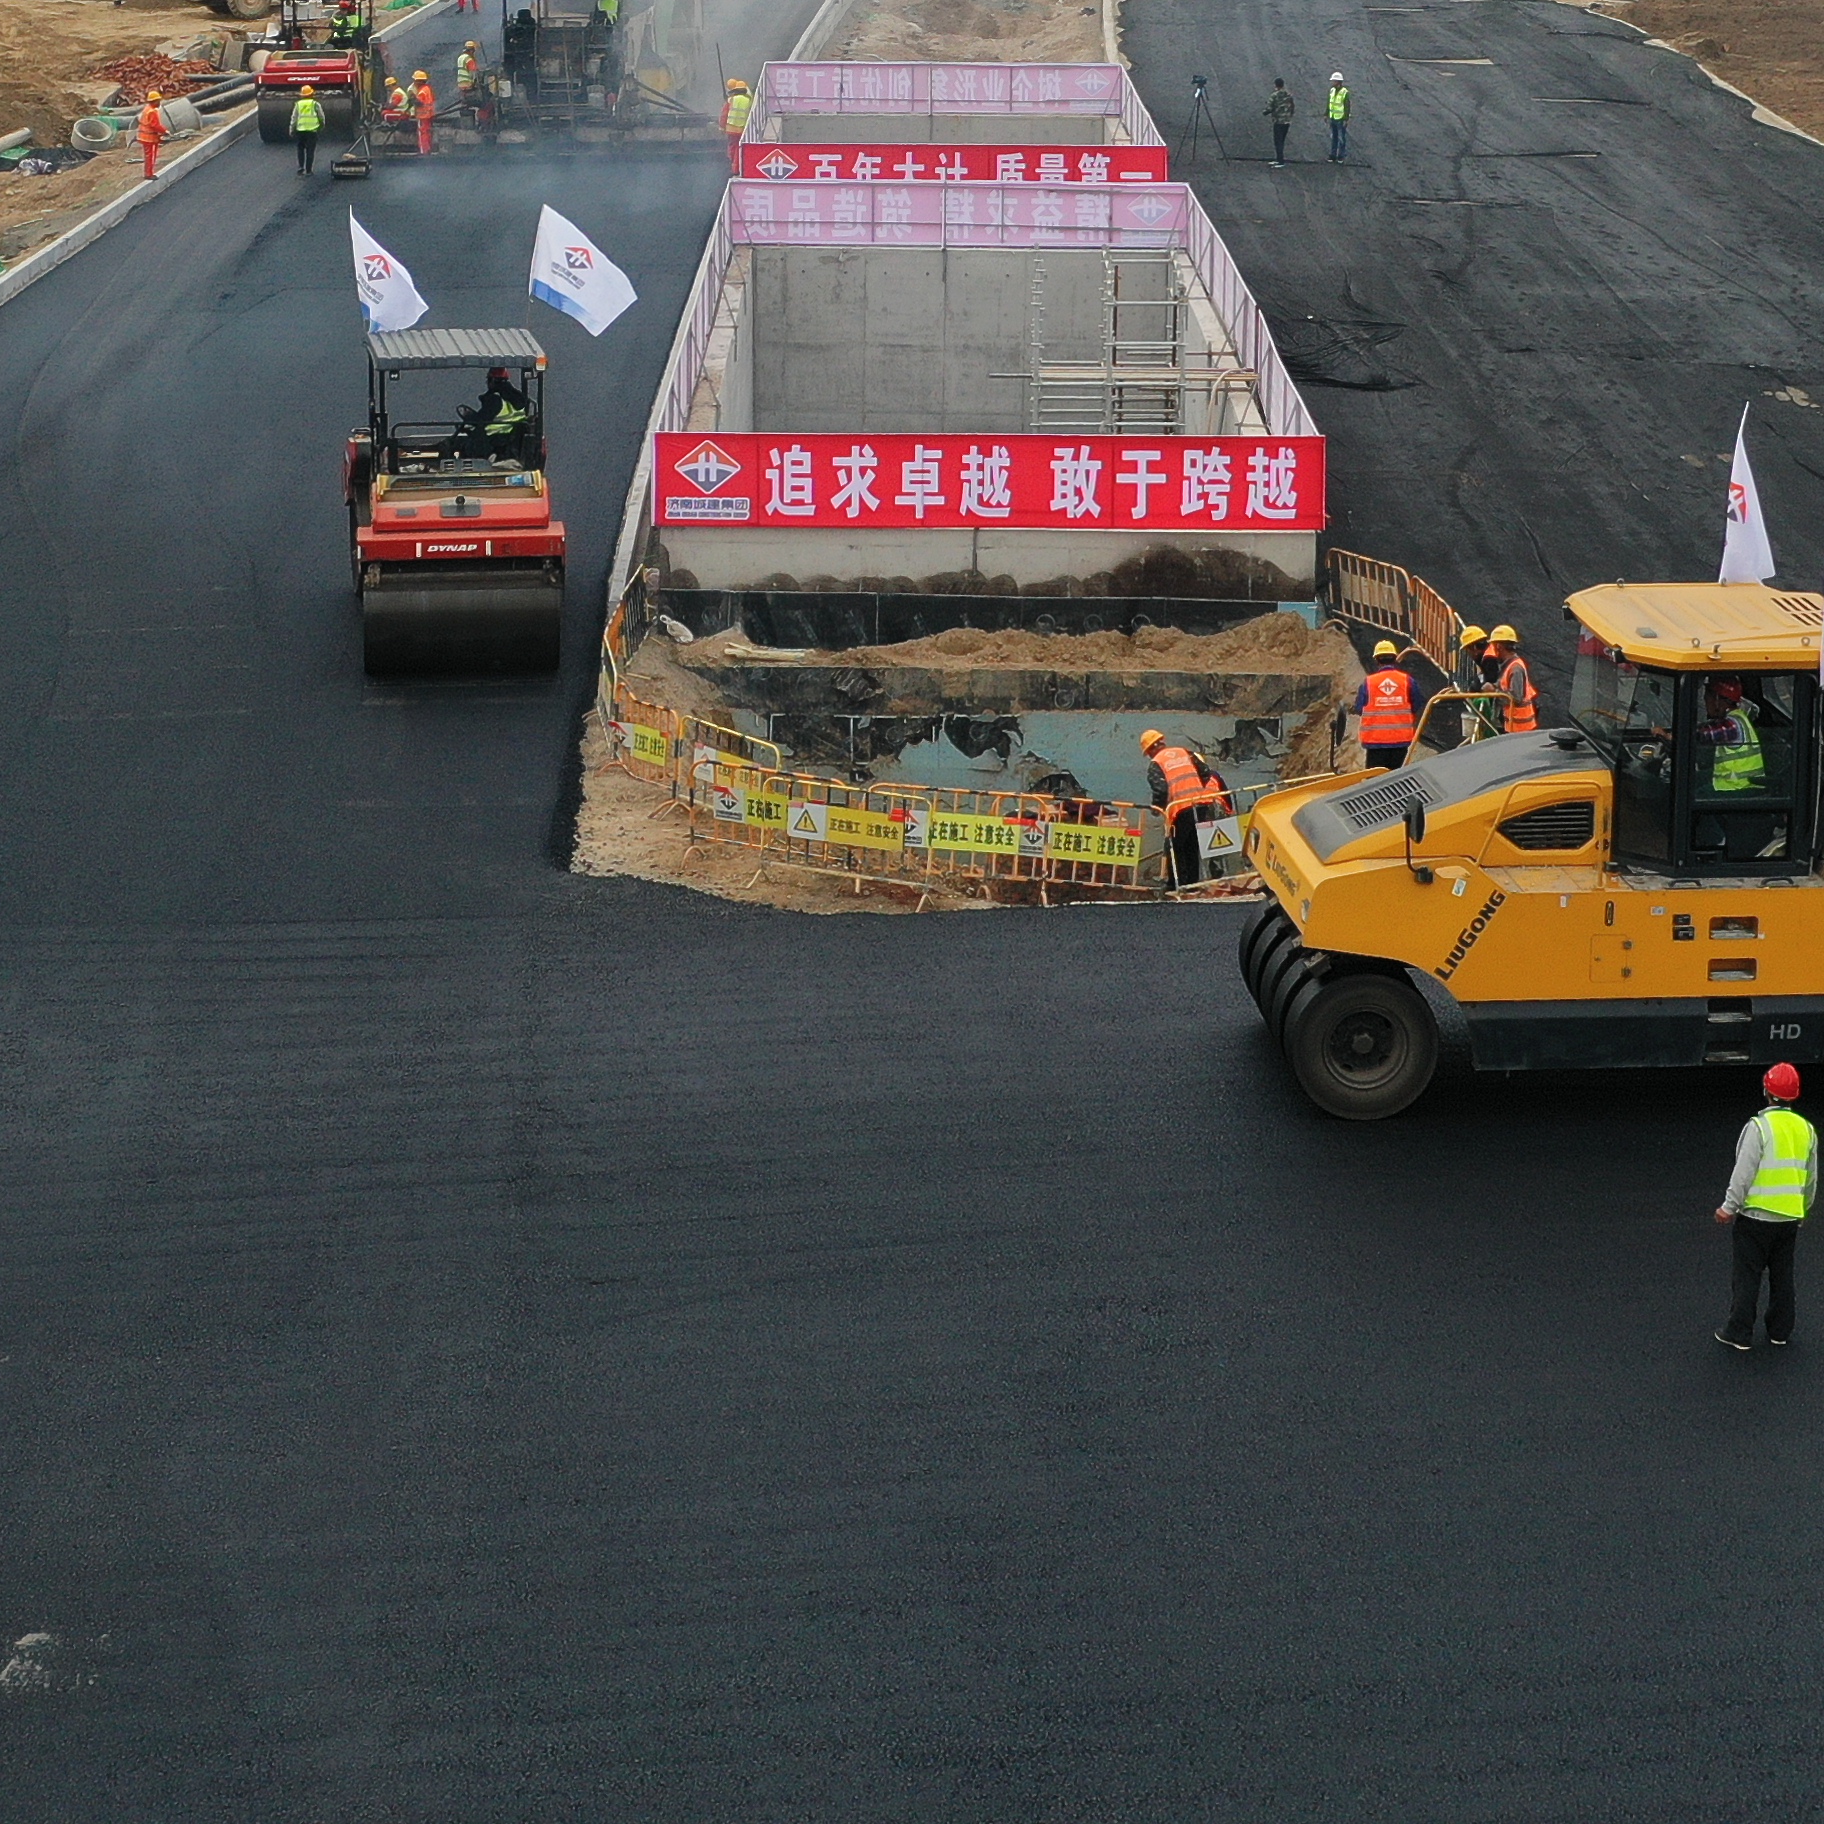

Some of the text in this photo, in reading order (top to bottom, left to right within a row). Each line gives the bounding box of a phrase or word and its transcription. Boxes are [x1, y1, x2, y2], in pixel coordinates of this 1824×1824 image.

[808, 152, 1153, 181] 百年大计 质量第一
[765, 444, 1298, 519] 追求卓越 敢于跨越
[668, 498, 748, 511] 济南城建集团
[427, 544, 477, 552] DYNAP
[747, 798, 782, 821] 正在施工
[829, 817, 860, 835] 正在施工
[866, 823, 899, 841] 注意安全
[975, 824, 1016, 846] 注意安全
[1053, 831, 1092, 851] 正在施工
[1096, 835, 1136, 857] 注意安全
[1769, 1023, 1801, 1040] HD
